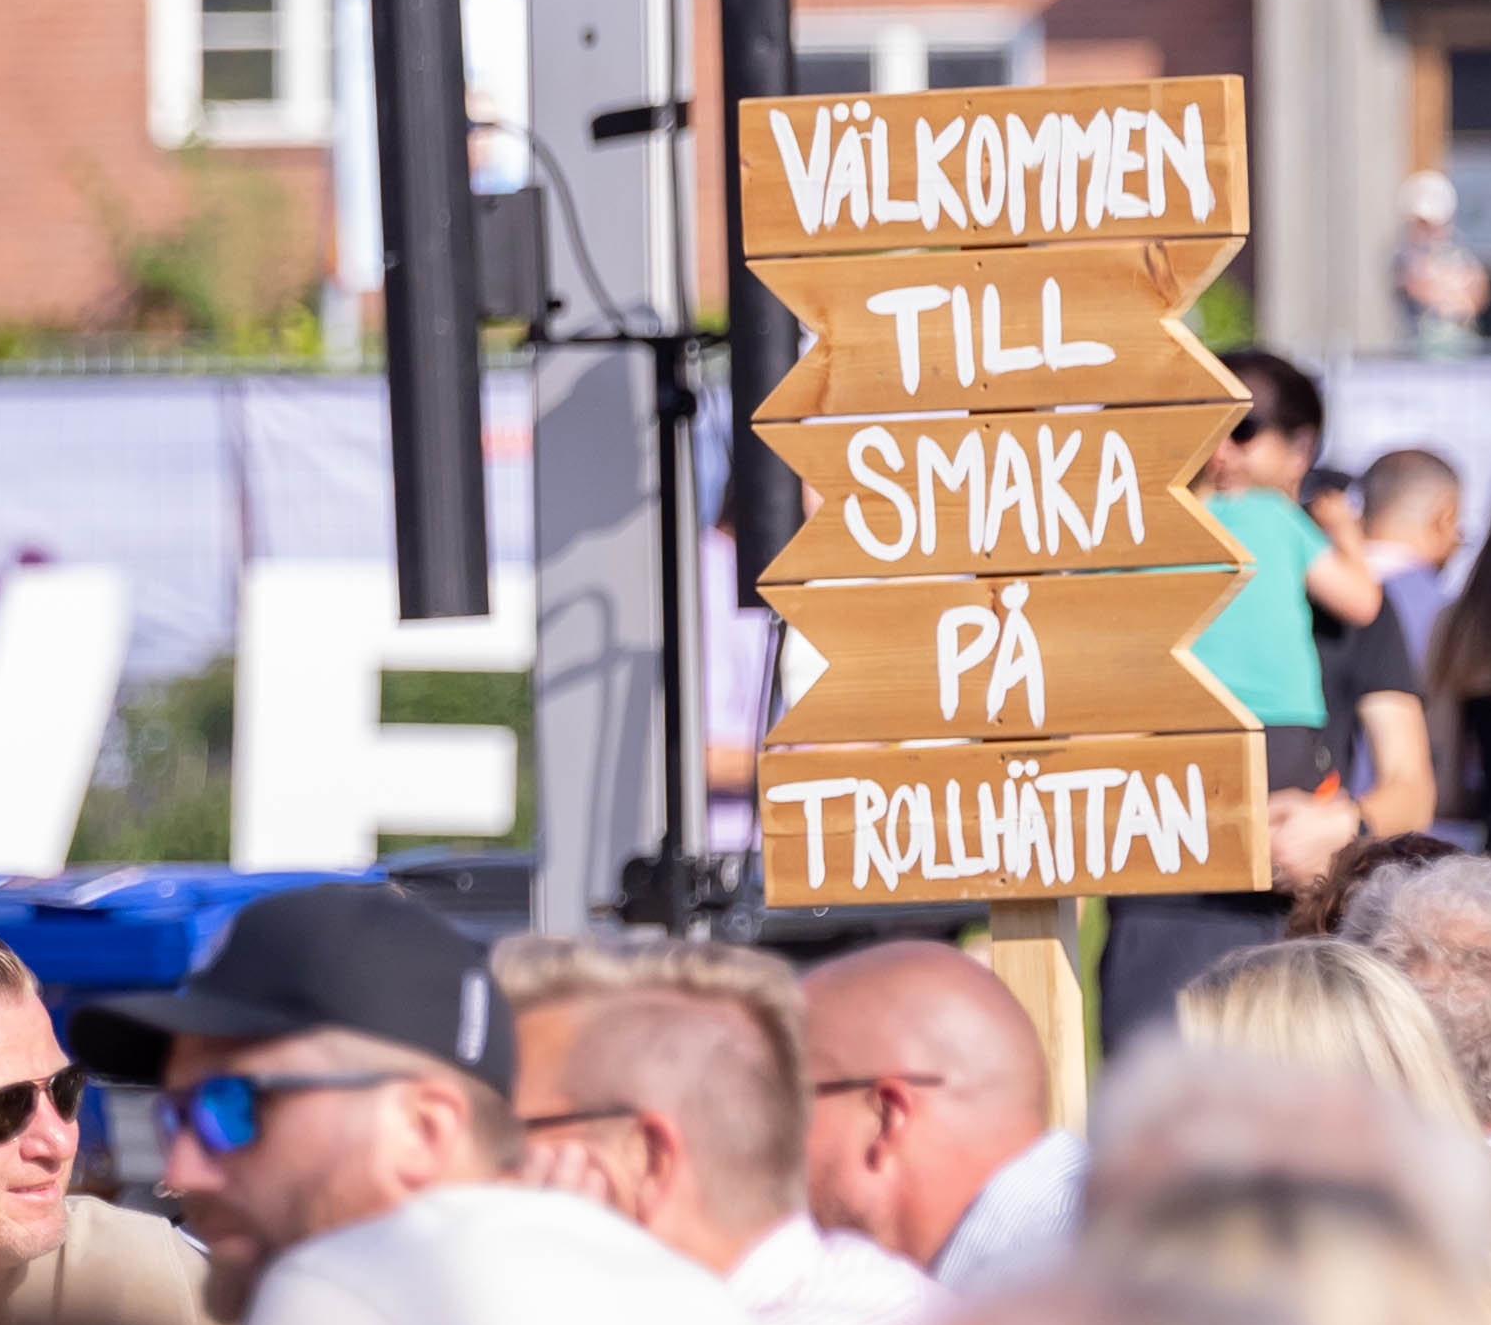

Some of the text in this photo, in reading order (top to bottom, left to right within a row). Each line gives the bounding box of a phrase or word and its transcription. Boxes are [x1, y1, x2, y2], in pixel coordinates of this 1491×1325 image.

[769, 100, 1215, 235] VÄLKOMMEN
[866, 277, 1116, 395] TILL
[843, 425, 1144, 562] SMAKA
[936, 580, 1046, 729] PÅ
[766, 760, 1209, 891] TROLLHÄTTAN
